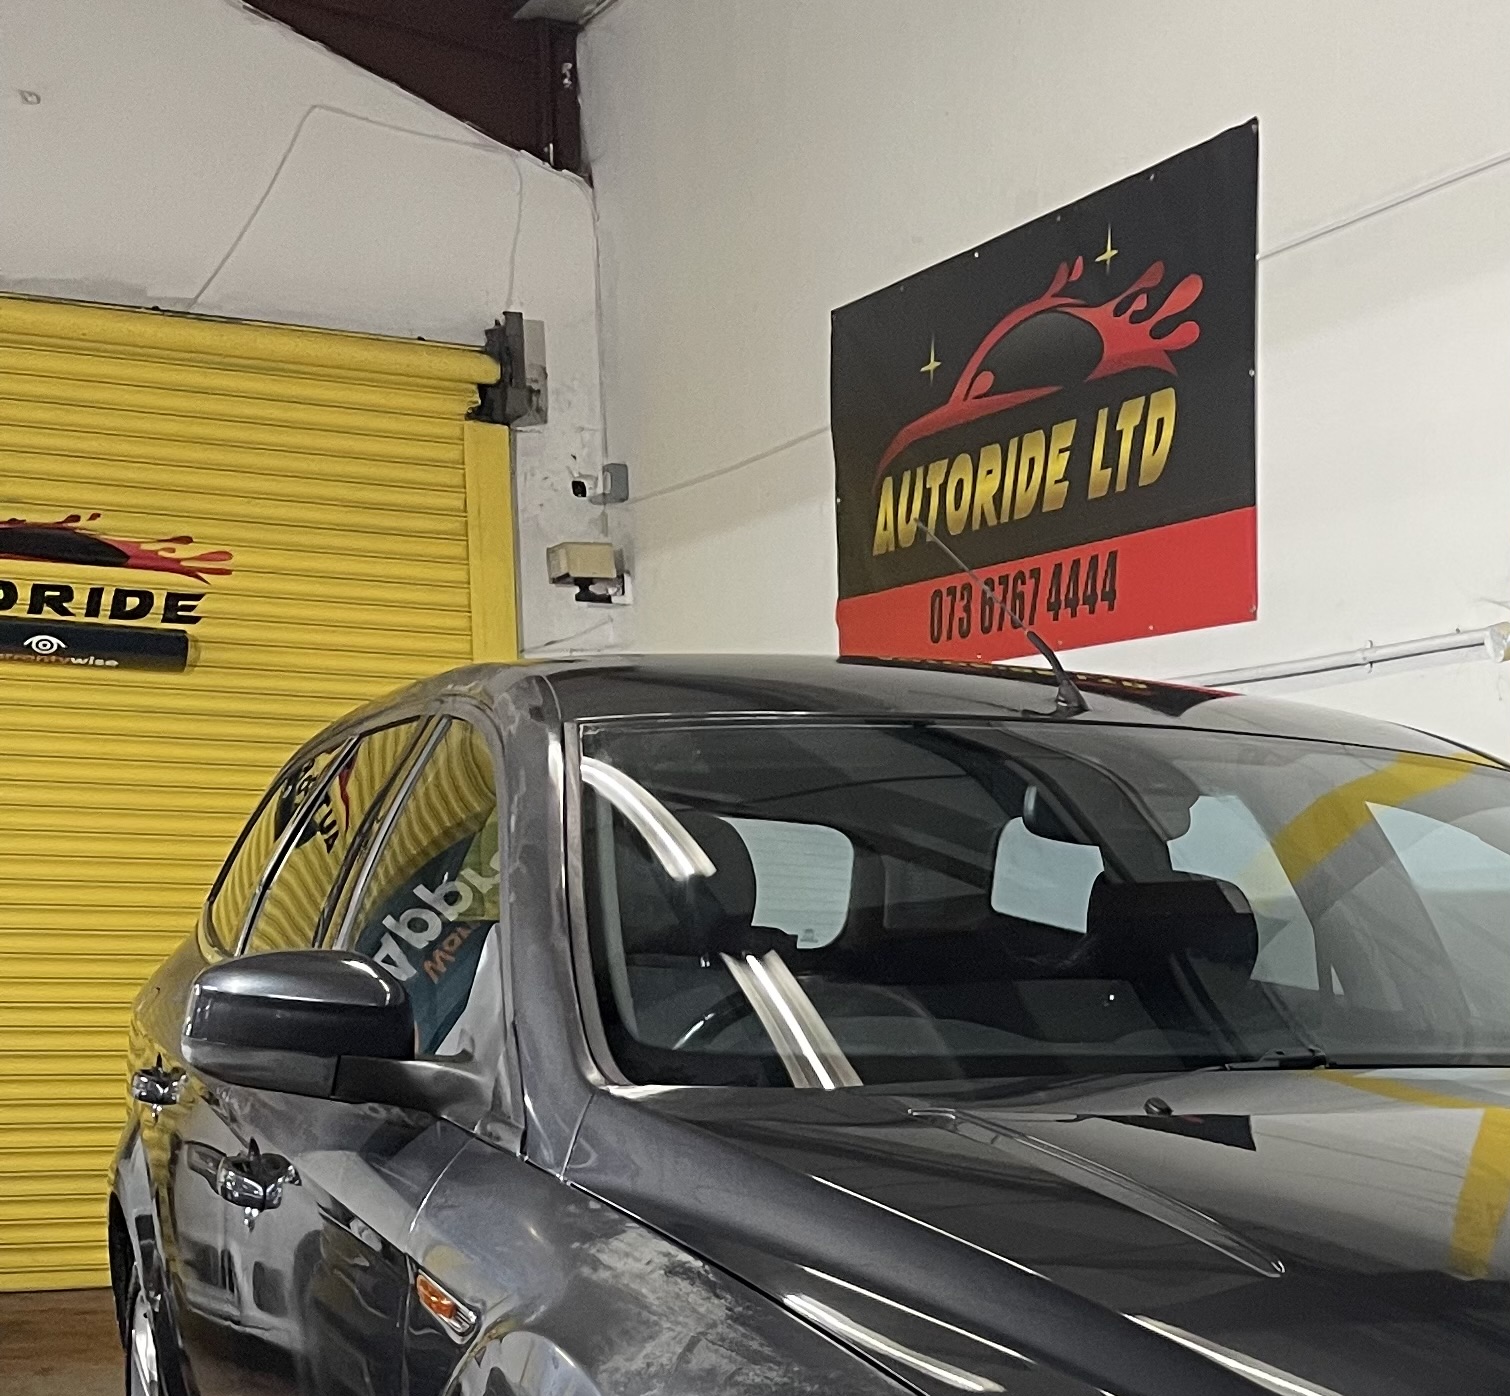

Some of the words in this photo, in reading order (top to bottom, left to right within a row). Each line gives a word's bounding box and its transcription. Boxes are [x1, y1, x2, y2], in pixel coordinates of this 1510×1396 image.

[873, 419, 1077, 556] AUTORIDE
[1088, 387, 1176, 499] LTD
[930, 583, 972, 643] 073
[981, 568, 1041, 634] 6767
[1047, 550, 1118, 621] 4444
